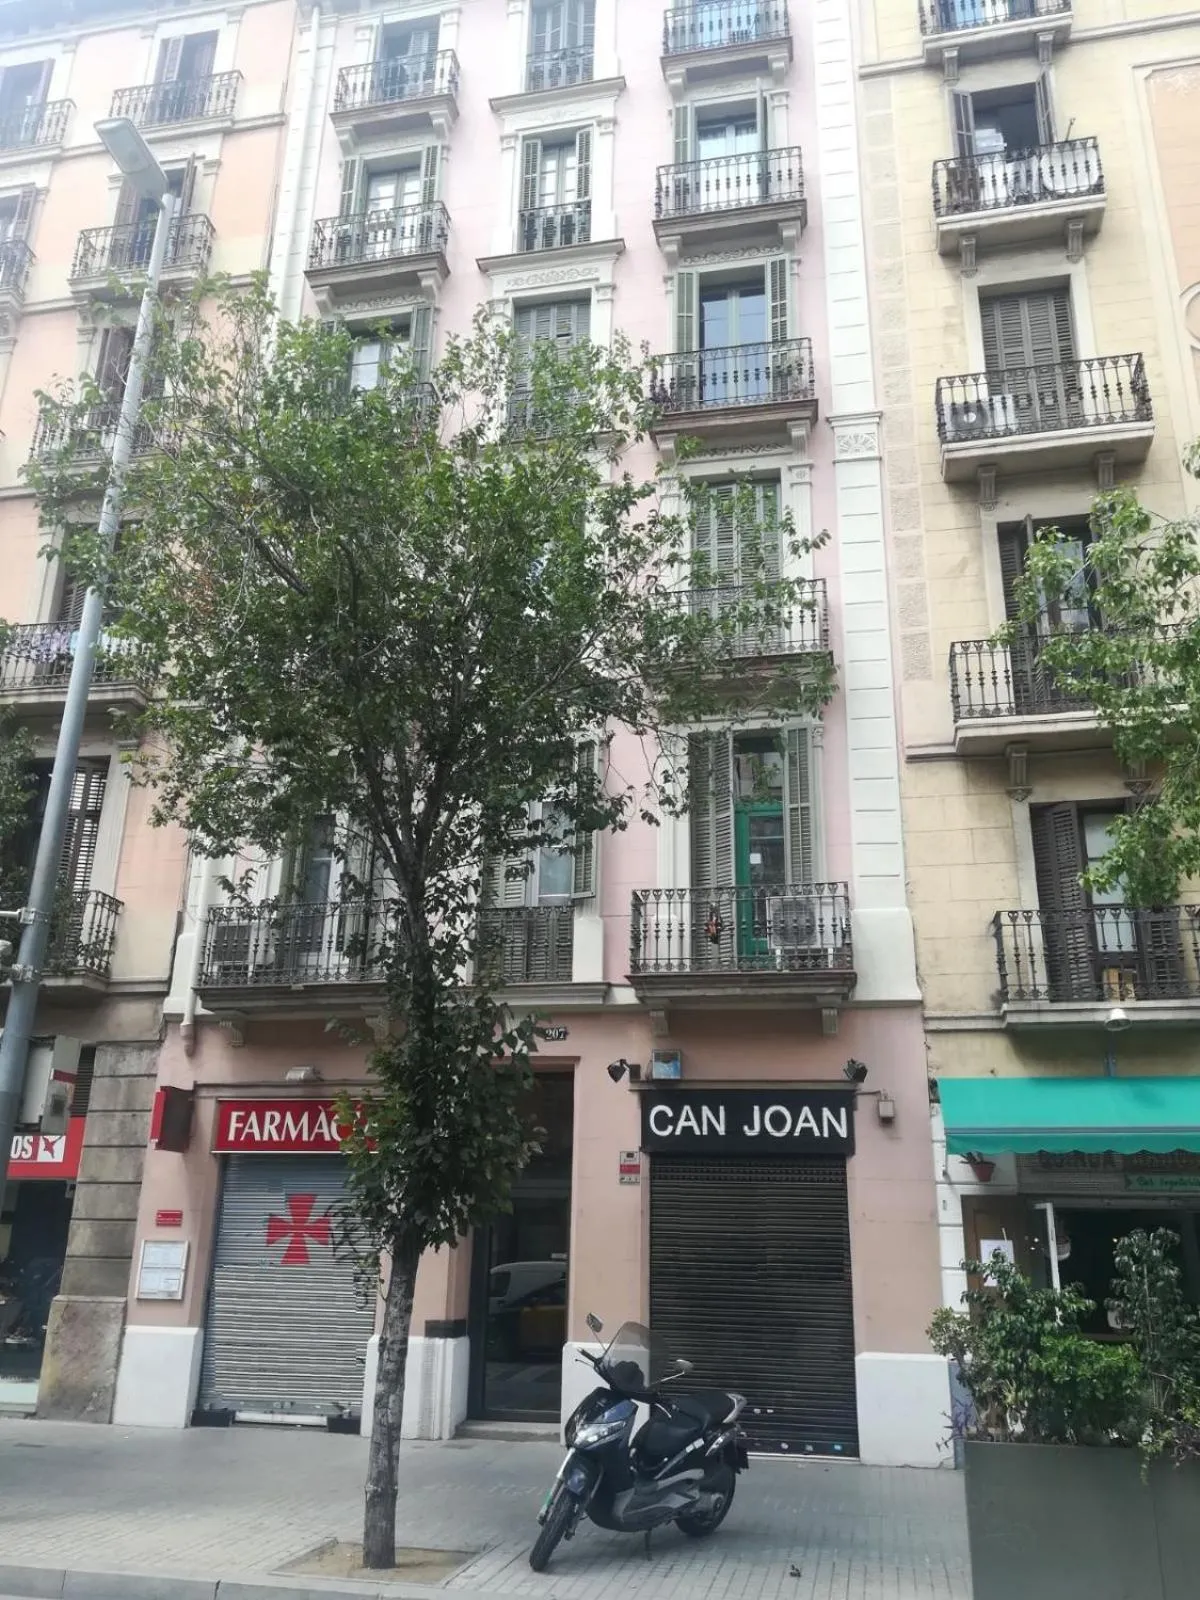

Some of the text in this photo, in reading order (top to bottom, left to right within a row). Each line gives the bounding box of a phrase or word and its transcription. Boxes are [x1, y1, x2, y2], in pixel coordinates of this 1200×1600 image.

[545, 1028, 566, 1040] 207
[649, 1104, 849, 1139] CAN JOAN
